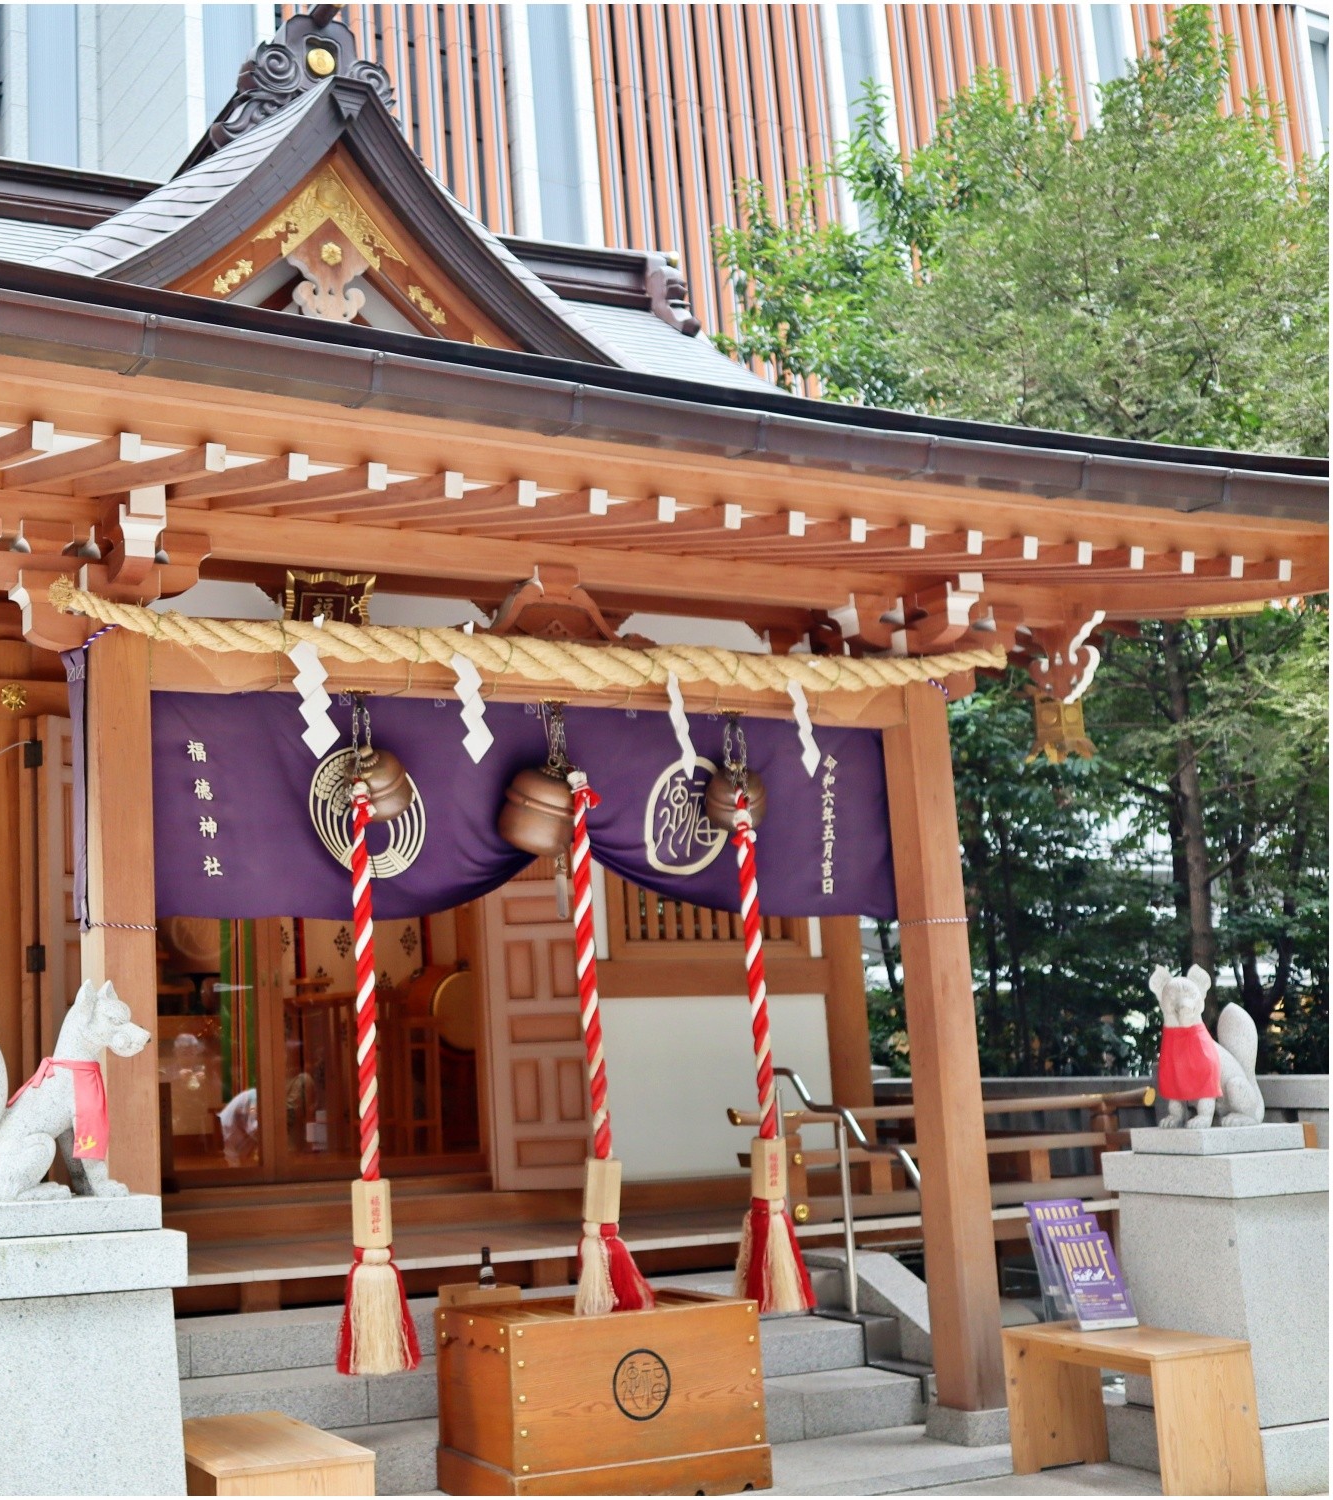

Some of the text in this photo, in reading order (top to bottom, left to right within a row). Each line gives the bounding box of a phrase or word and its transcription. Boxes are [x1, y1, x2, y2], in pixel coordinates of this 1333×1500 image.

[187, 739, 223, 877] 福徳神社
[821, 754, 838, 894] 令和六年五月吉日
